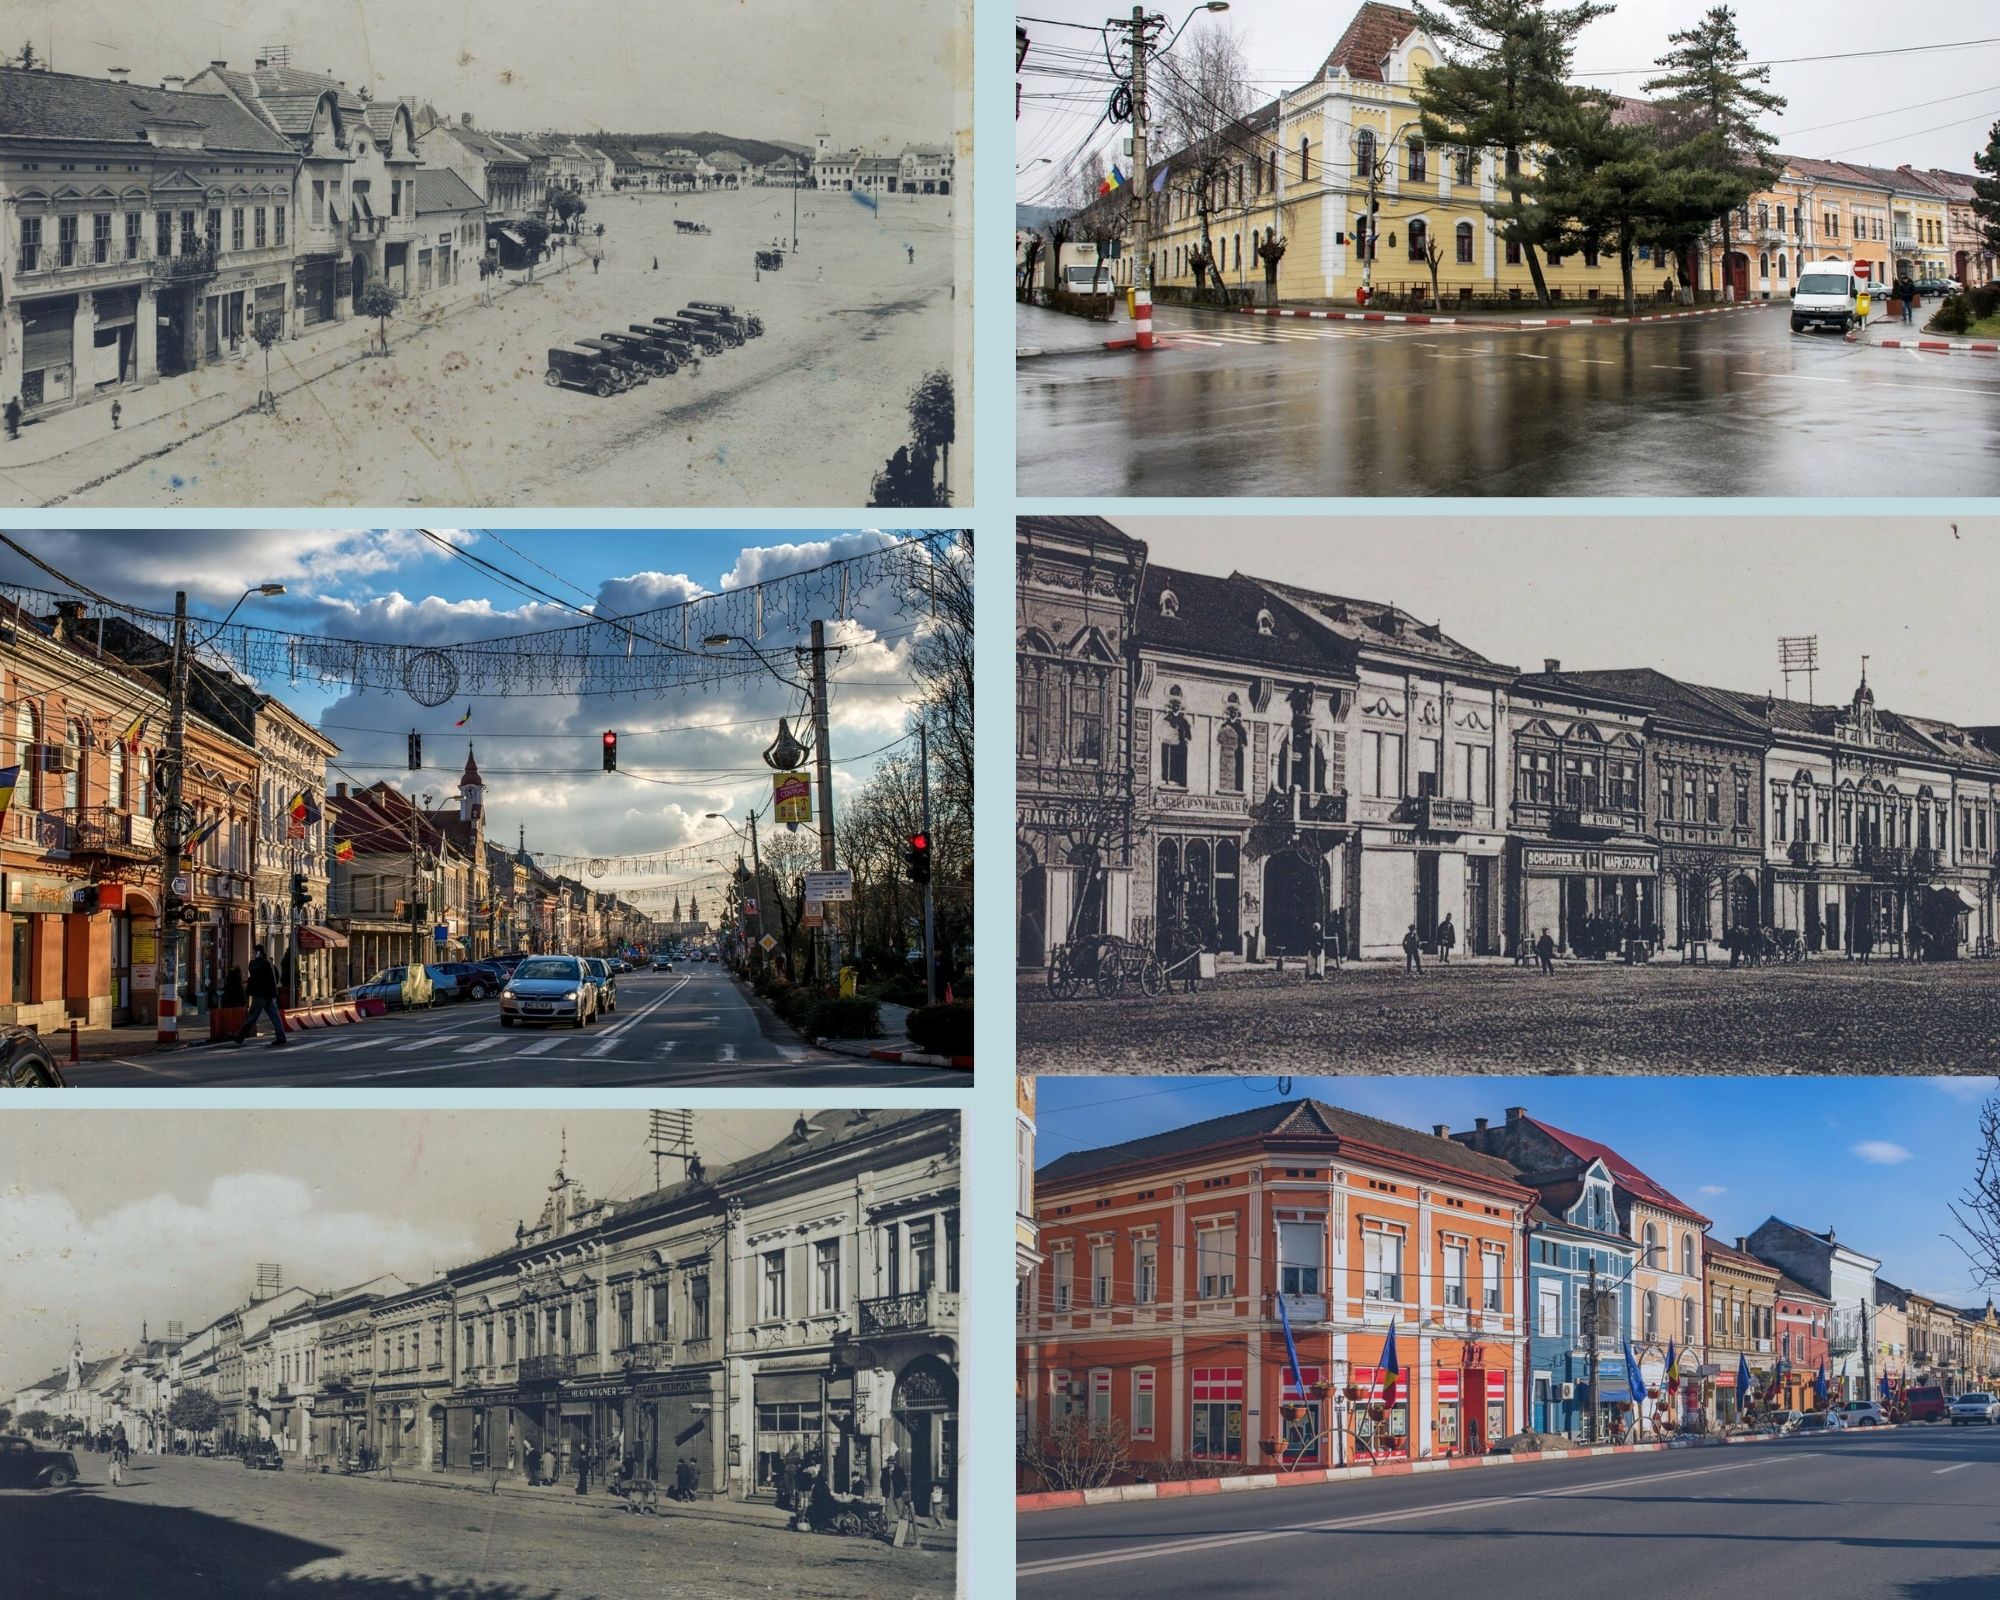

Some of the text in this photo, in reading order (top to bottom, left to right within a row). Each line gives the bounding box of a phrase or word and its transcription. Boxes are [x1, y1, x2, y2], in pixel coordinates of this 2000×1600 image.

[1528, 852, 1573, 866] SCHUPITER
[65, 886, 86, 903] store
[571, 1388, 588, 1398] HUGO
[589, 1386, 617, 1397] WAGNER
